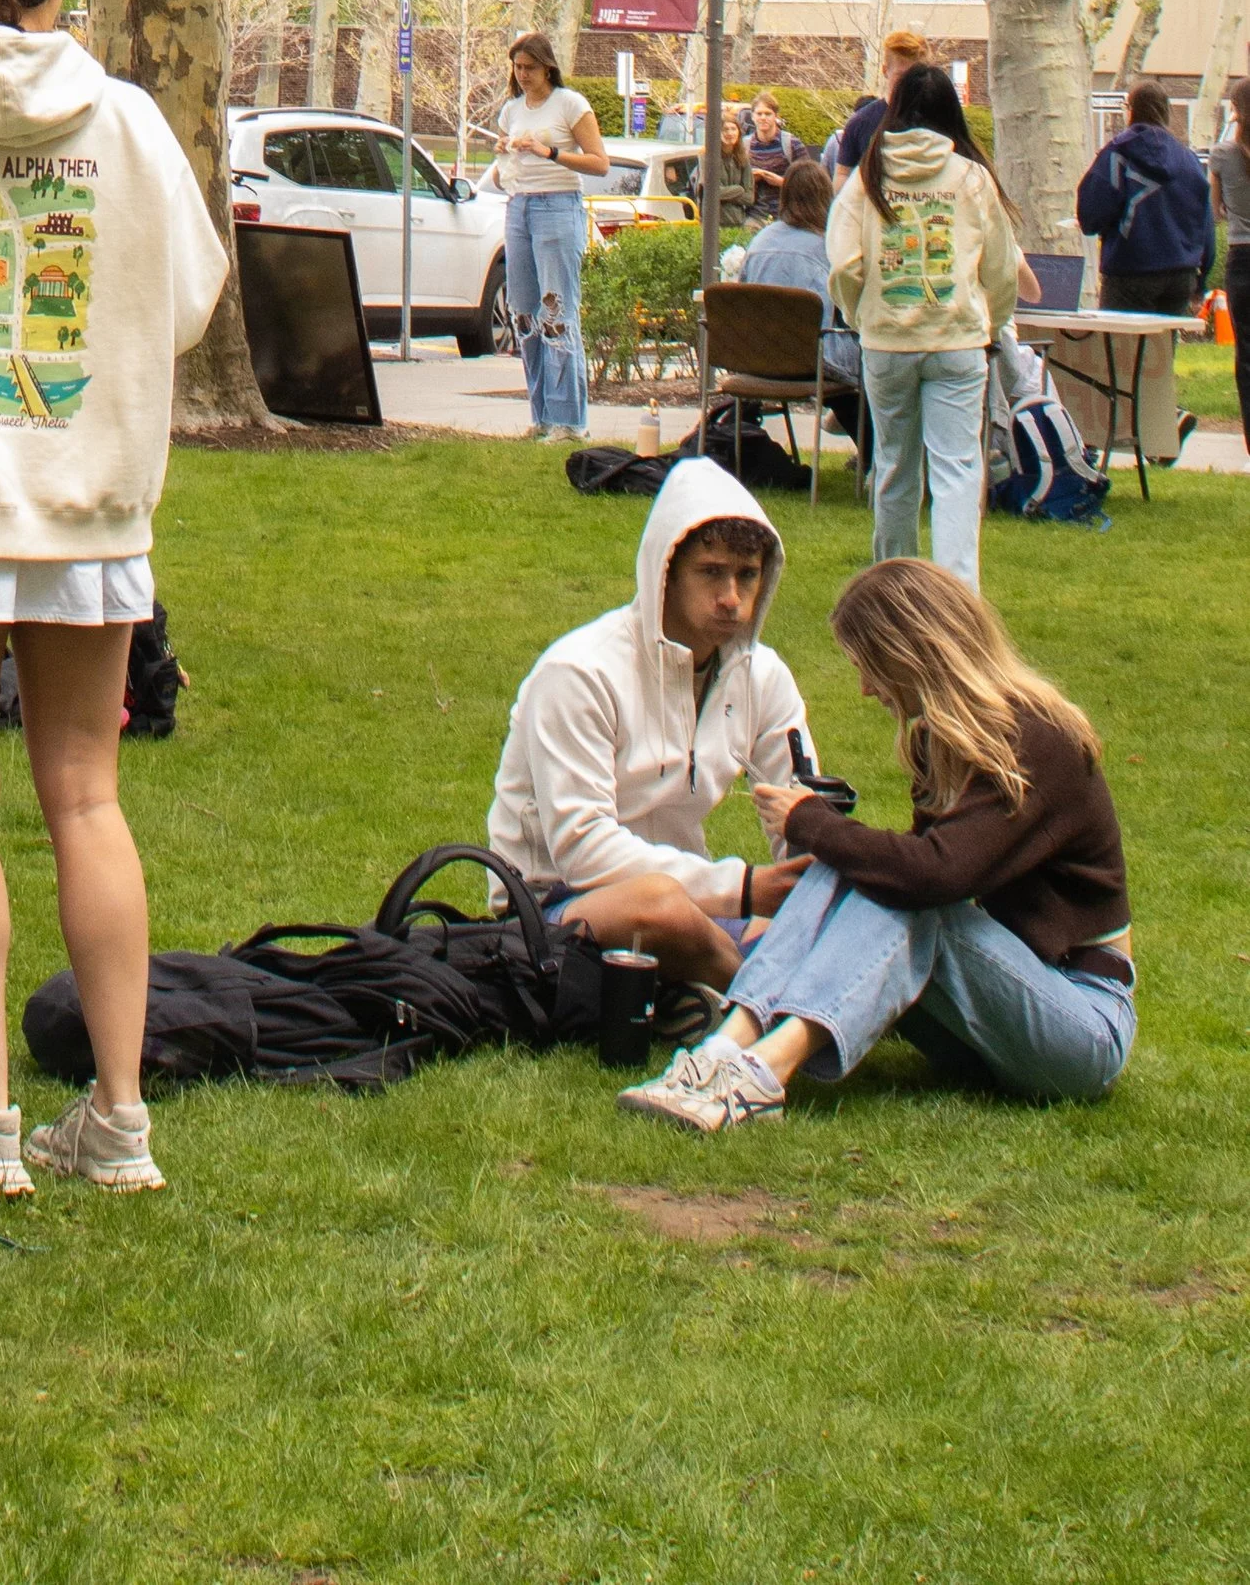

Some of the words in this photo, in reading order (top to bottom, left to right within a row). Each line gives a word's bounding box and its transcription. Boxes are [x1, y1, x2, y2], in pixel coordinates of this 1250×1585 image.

[2, 156, 55, 179] ALPHA
[58, 158, 99, 178] THETA
[887, 191, 911, 202] APPA
[31, 415, 69, 430] Theta
